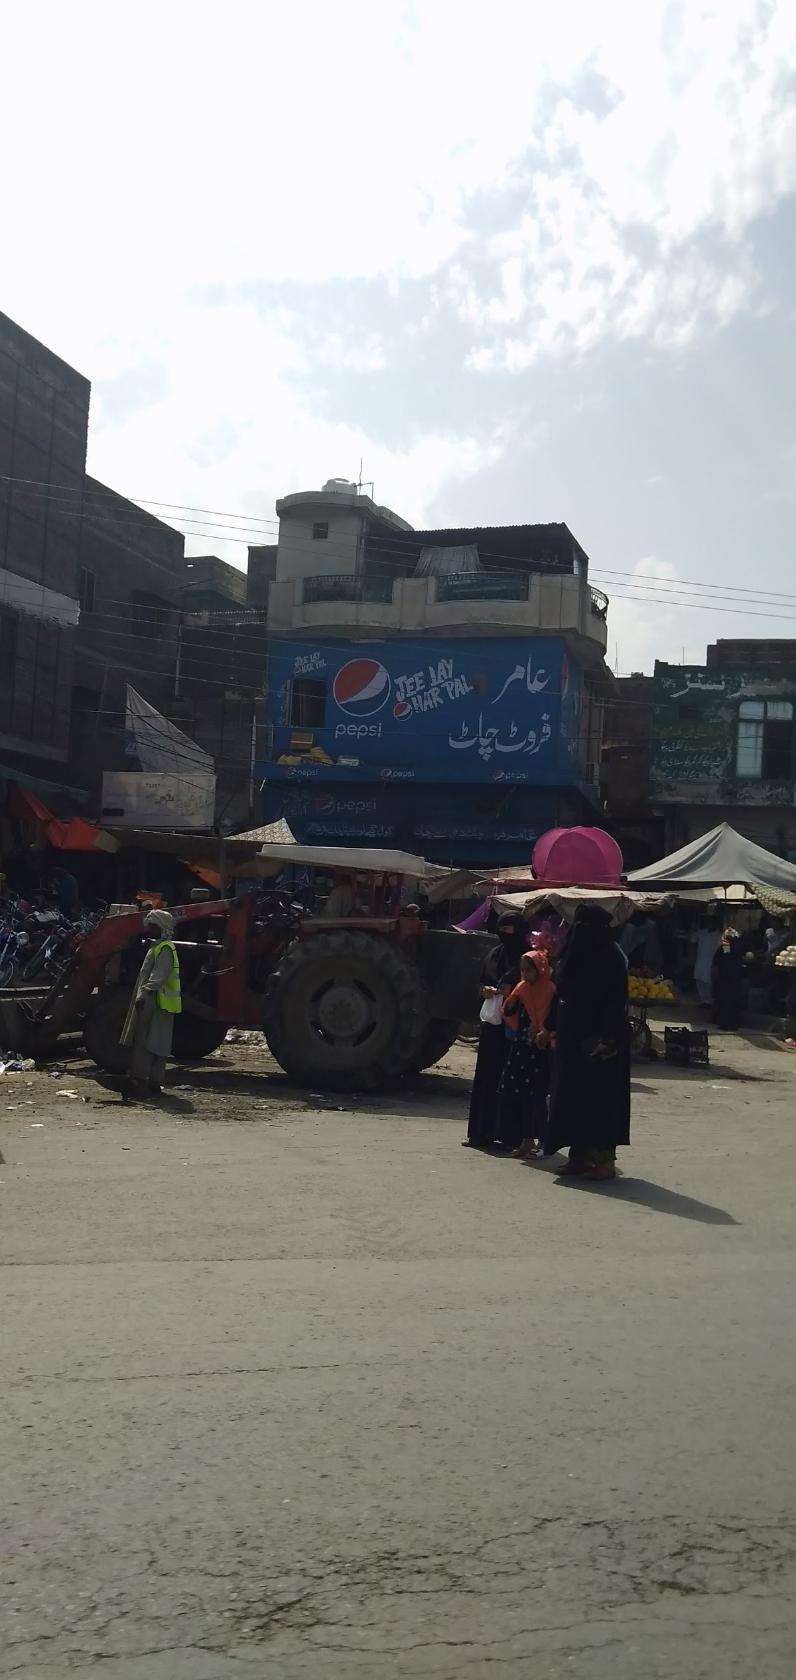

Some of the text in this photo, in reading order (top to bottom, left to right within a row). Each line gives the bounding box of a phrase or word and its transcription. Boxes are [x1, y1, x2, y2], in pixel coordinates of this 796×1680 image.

[393, 658, 454, 702] JEE JAY
[411, 673, 475, 713] HAR PAL
[490, 654, 552, 704] عامر
[335, 722, 382, 740] pepsi
[448, 711, 500, 761] چاٹ
[494, 712, 552, 755] فروٹ
